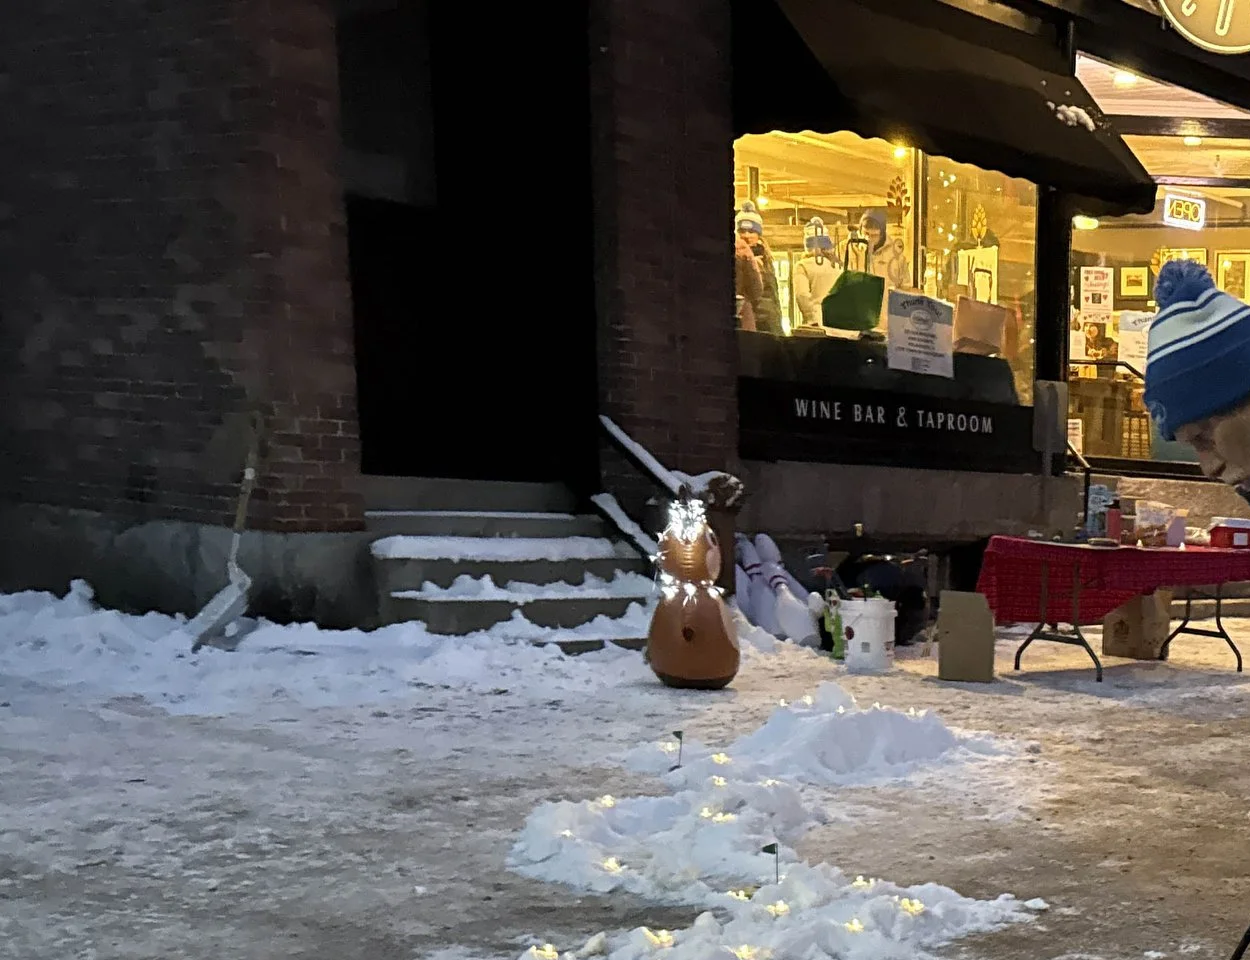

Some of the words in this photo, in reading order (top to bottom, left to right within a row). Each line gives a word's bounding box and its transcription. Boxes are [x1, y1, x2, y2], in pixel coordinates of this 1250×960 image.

[795, 398, 842, 420] WINE
[854, 404, 886, 424] BAR
[896, 406, 908, 428] &
[917, 410, 993, 433] TAPROOM
